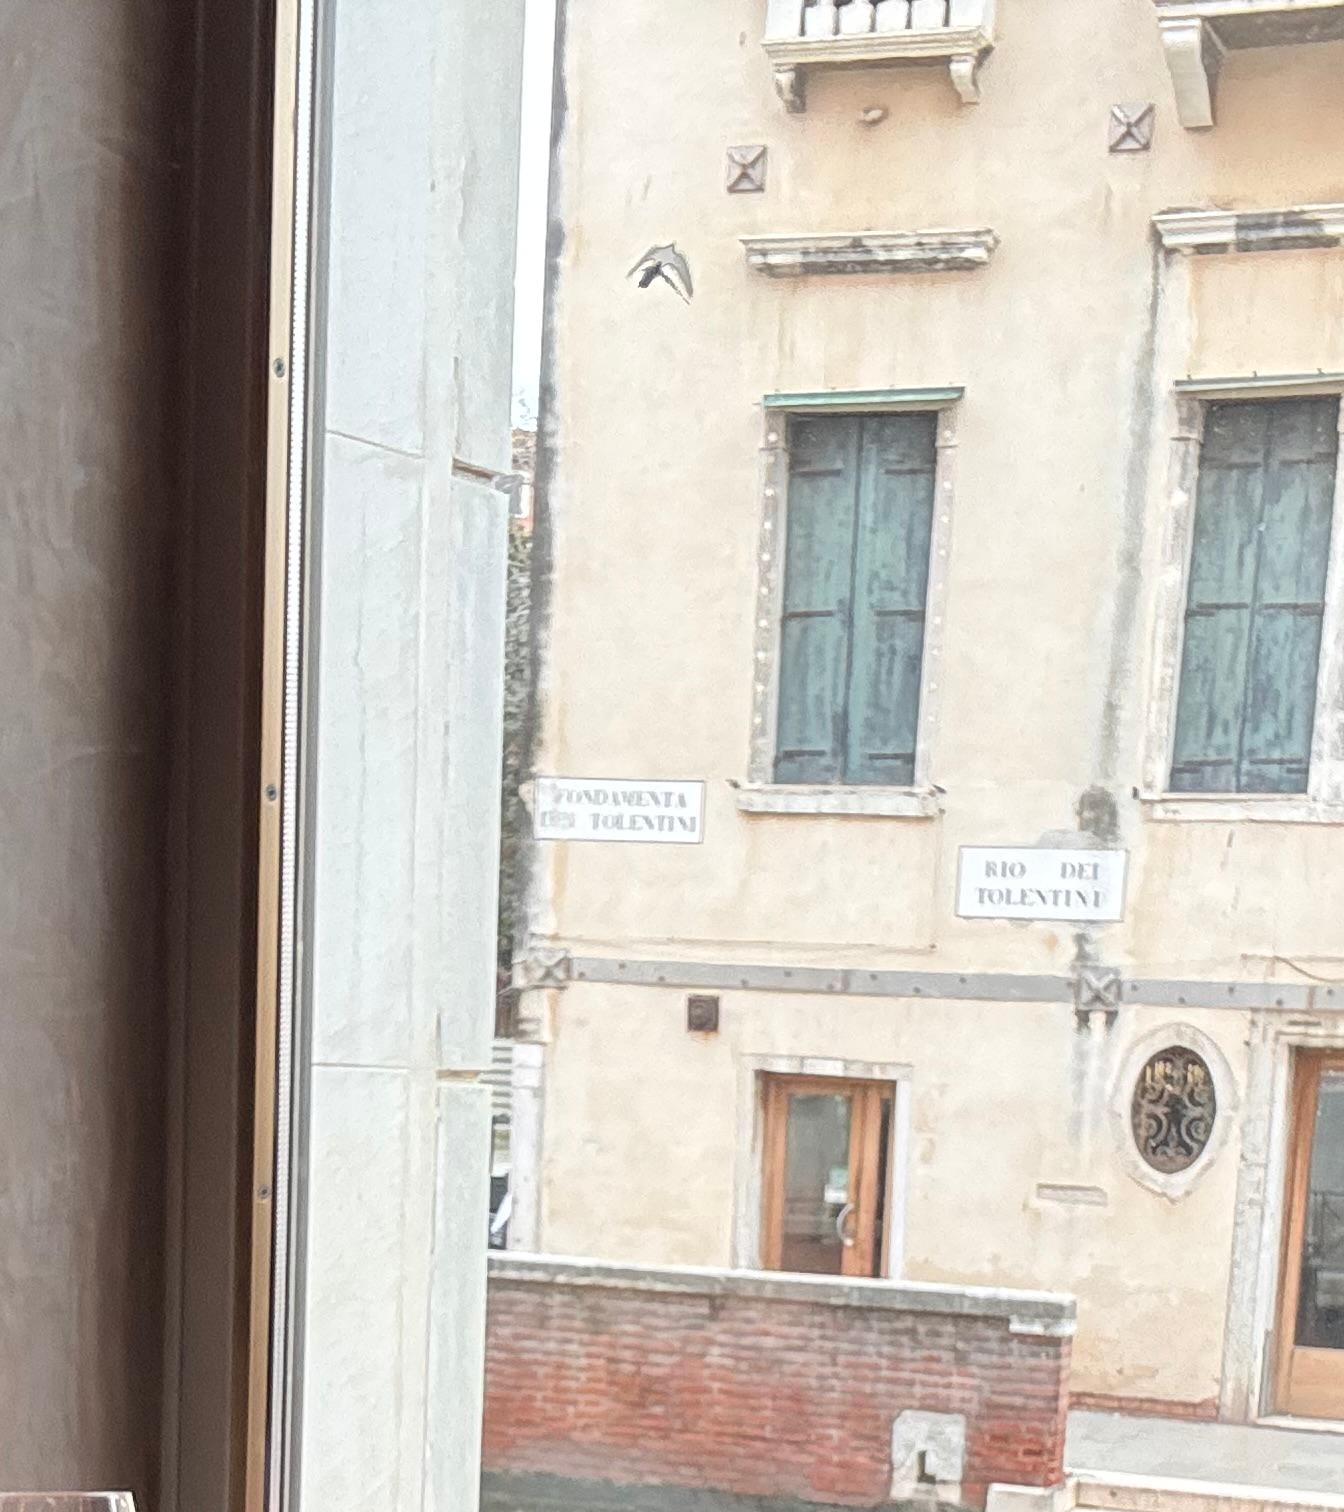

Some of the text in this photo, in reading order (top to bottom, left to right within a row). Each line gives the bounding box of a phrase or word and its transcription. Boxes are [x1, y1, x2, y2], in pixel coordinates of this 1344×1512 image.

[984, 859, 1099, 881] RIO DEI
[974, 886, 1101, 909] TOLENTINI
